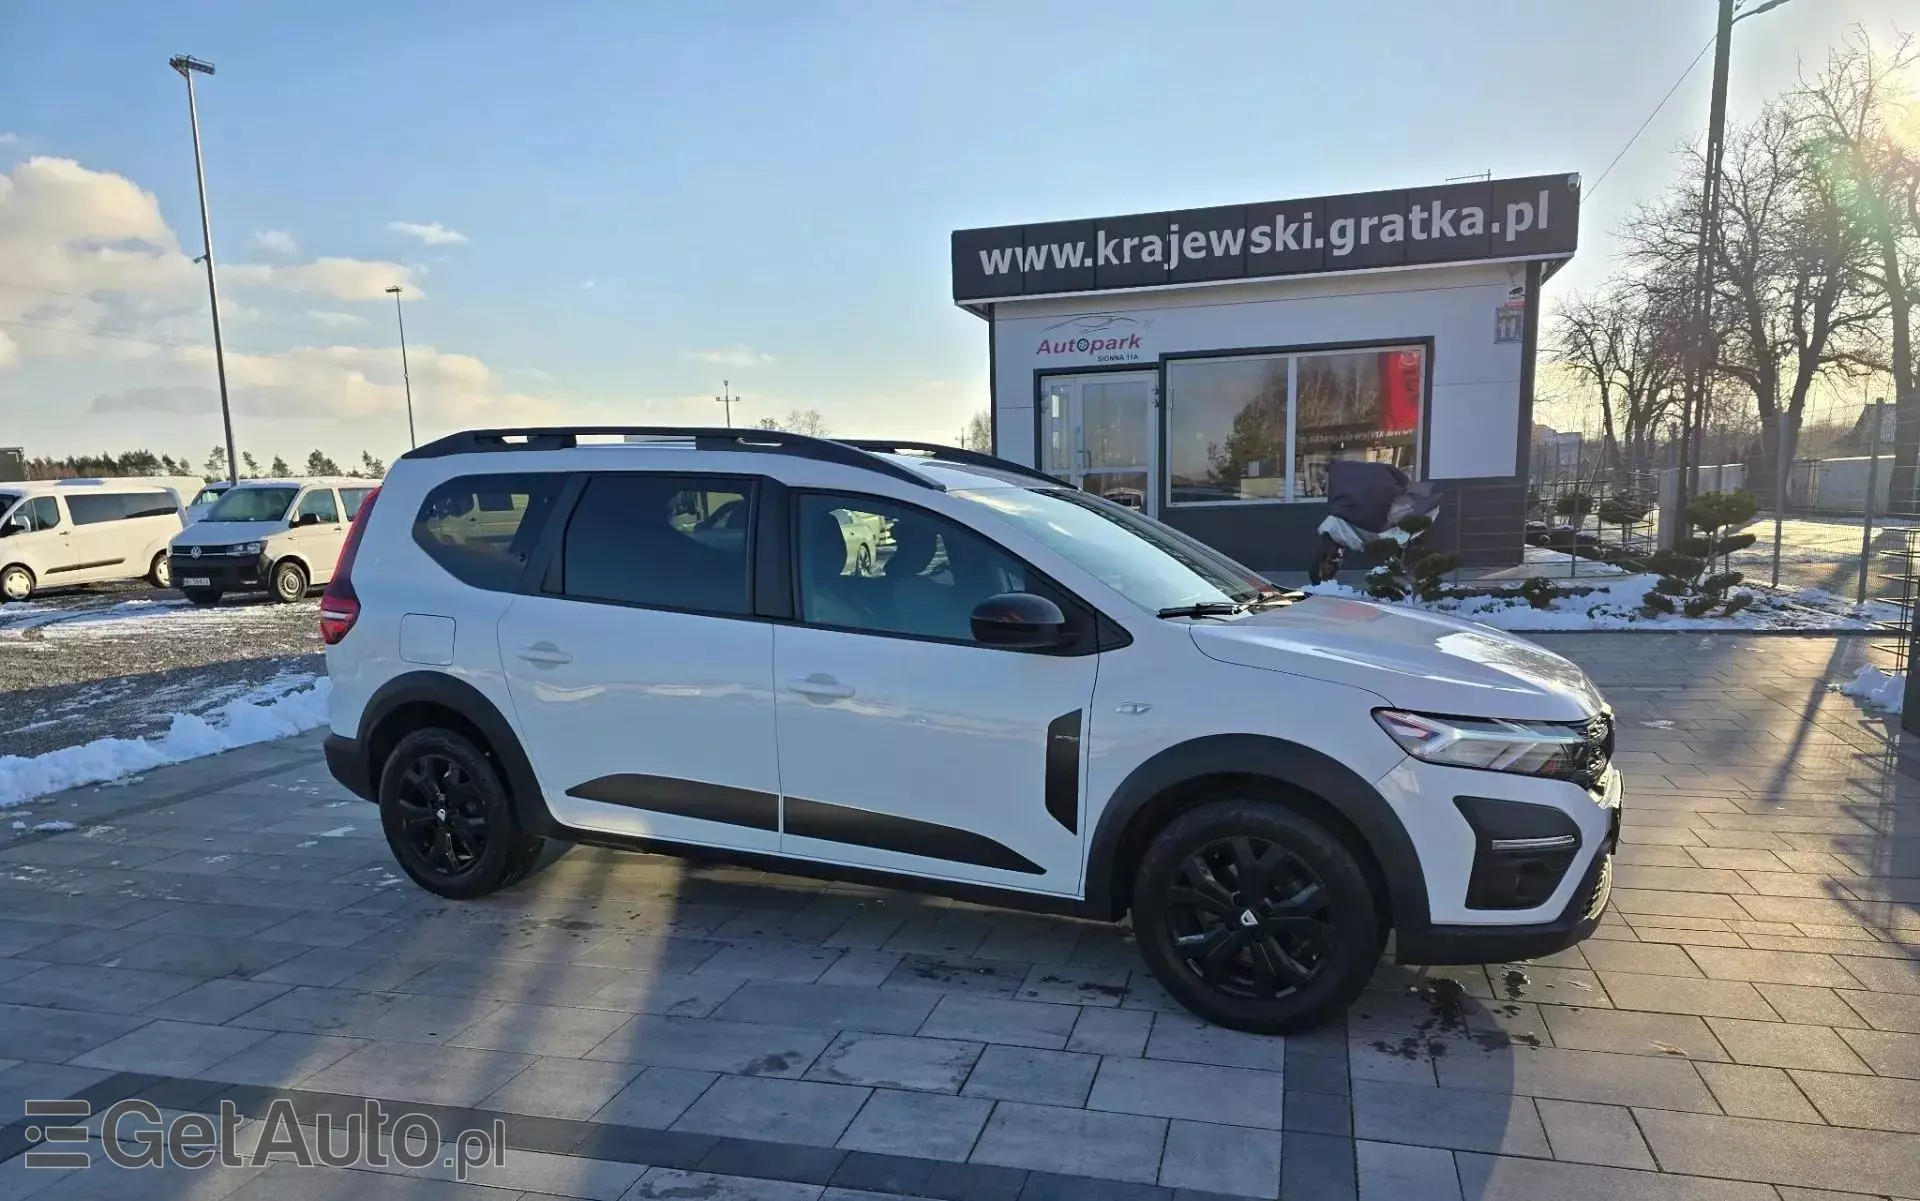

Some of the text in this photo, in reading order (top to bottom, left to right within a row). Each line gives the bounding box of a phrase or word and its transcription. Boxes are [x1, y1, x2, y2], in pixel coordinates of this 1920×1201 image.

[978, 190, 1550, 276] www.krajewski.gratka.pl
[1036, 333, 1143, 355] Autopark
[1097, 354, 1125, 362] SIONNA
